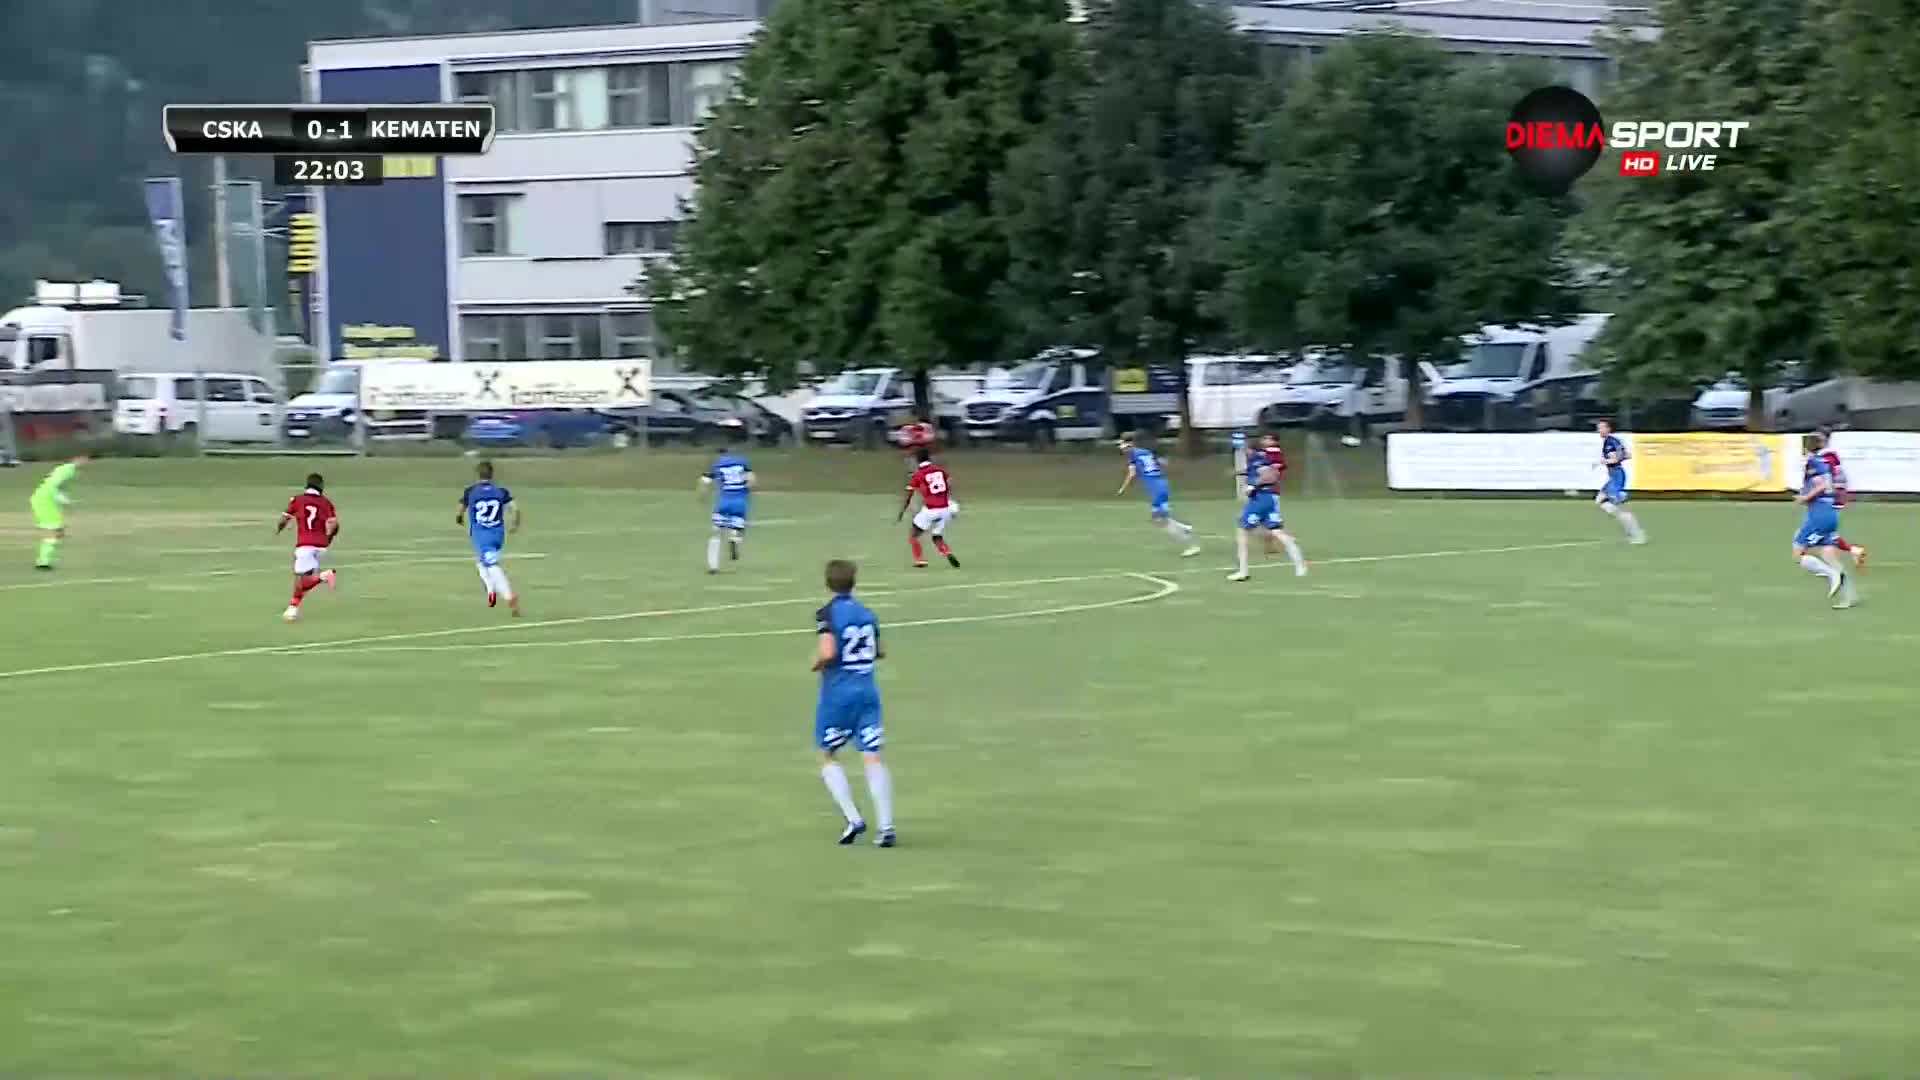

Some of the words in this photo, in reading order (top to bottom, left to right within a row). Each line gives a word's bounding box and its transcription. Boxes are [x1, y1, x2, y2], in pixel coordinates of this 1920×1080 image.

[304, 505, 318, 529] 7
[475, 499, 500, 522] 27
[841, 622, 878, 663] 23
